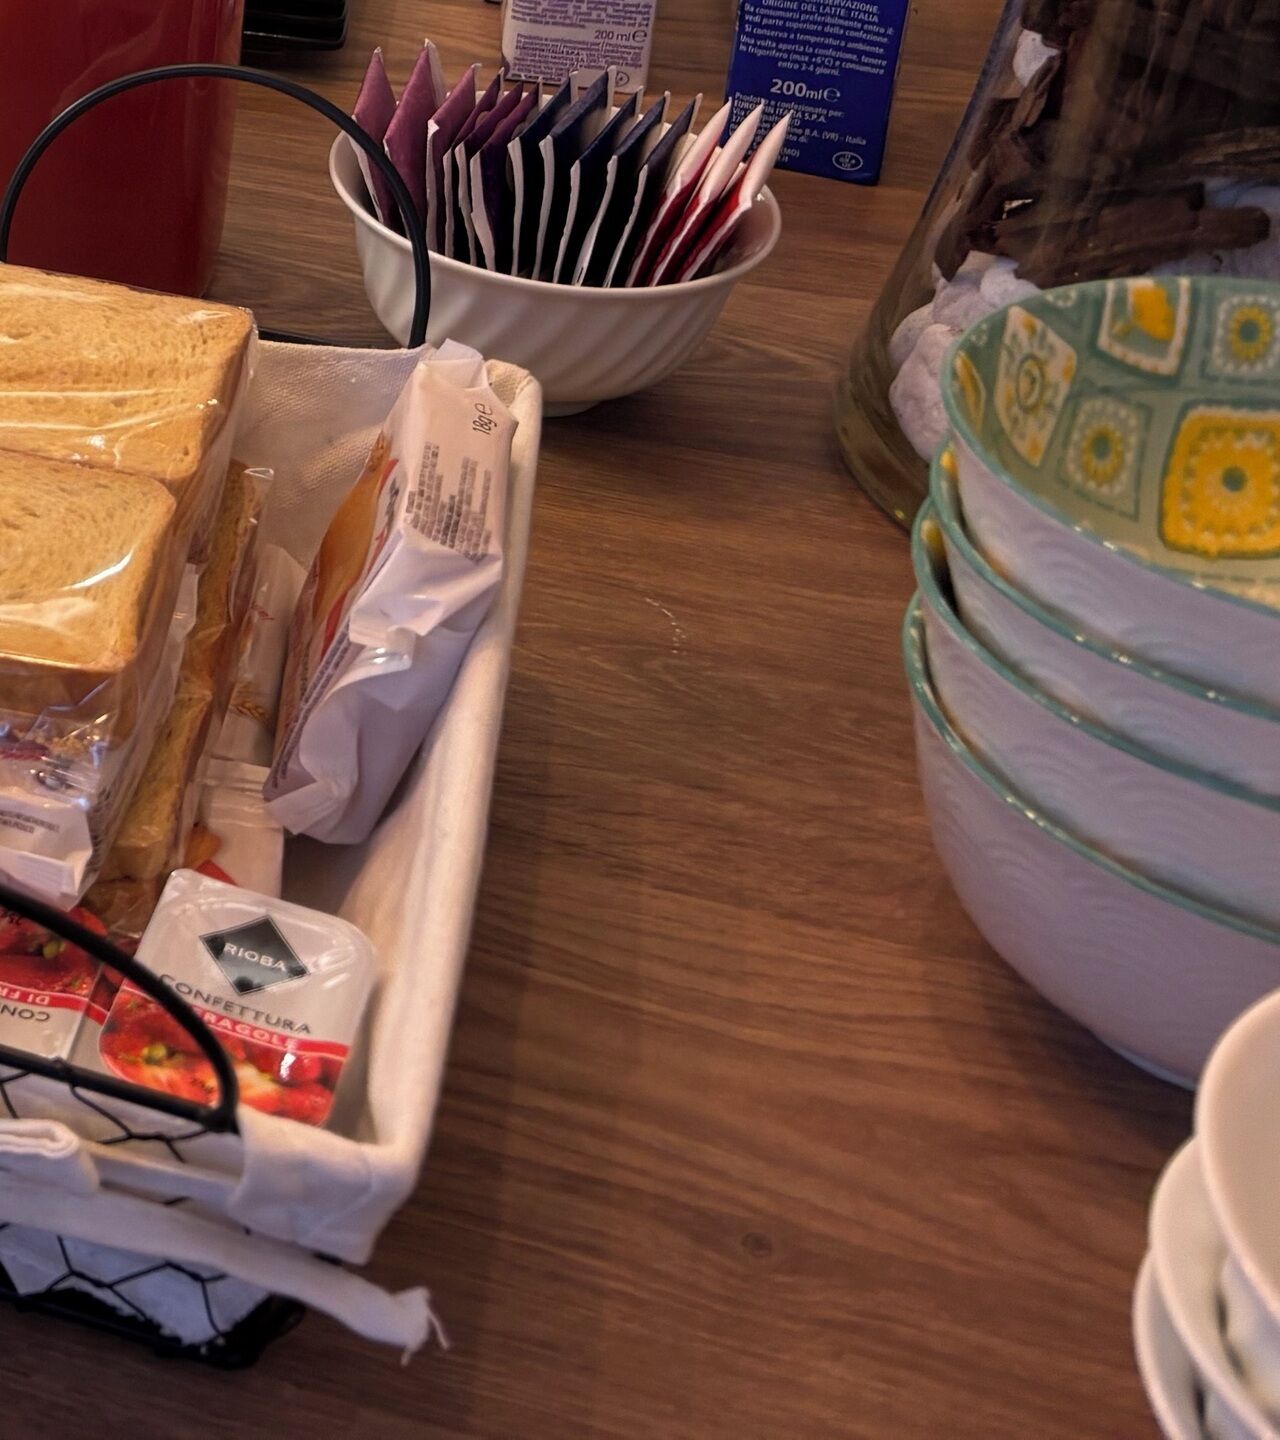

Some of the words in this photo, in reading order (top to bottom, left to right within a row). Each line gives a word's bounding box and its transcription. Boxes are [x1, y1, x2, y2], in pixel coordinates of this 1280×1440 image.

[762, 0, 799, 10] ORIGINE
[801, 3, 817, 12] DEL
[851, 10, 879, 22] ITALIA
[595, 30, 614, 40] 200
[616, 31, 630, 41] ml
[223, 943, 287, 972] RIOBA
[27, 993, 50, 1005] DI
[159, 973, 311, 1035] CONFETTURA
